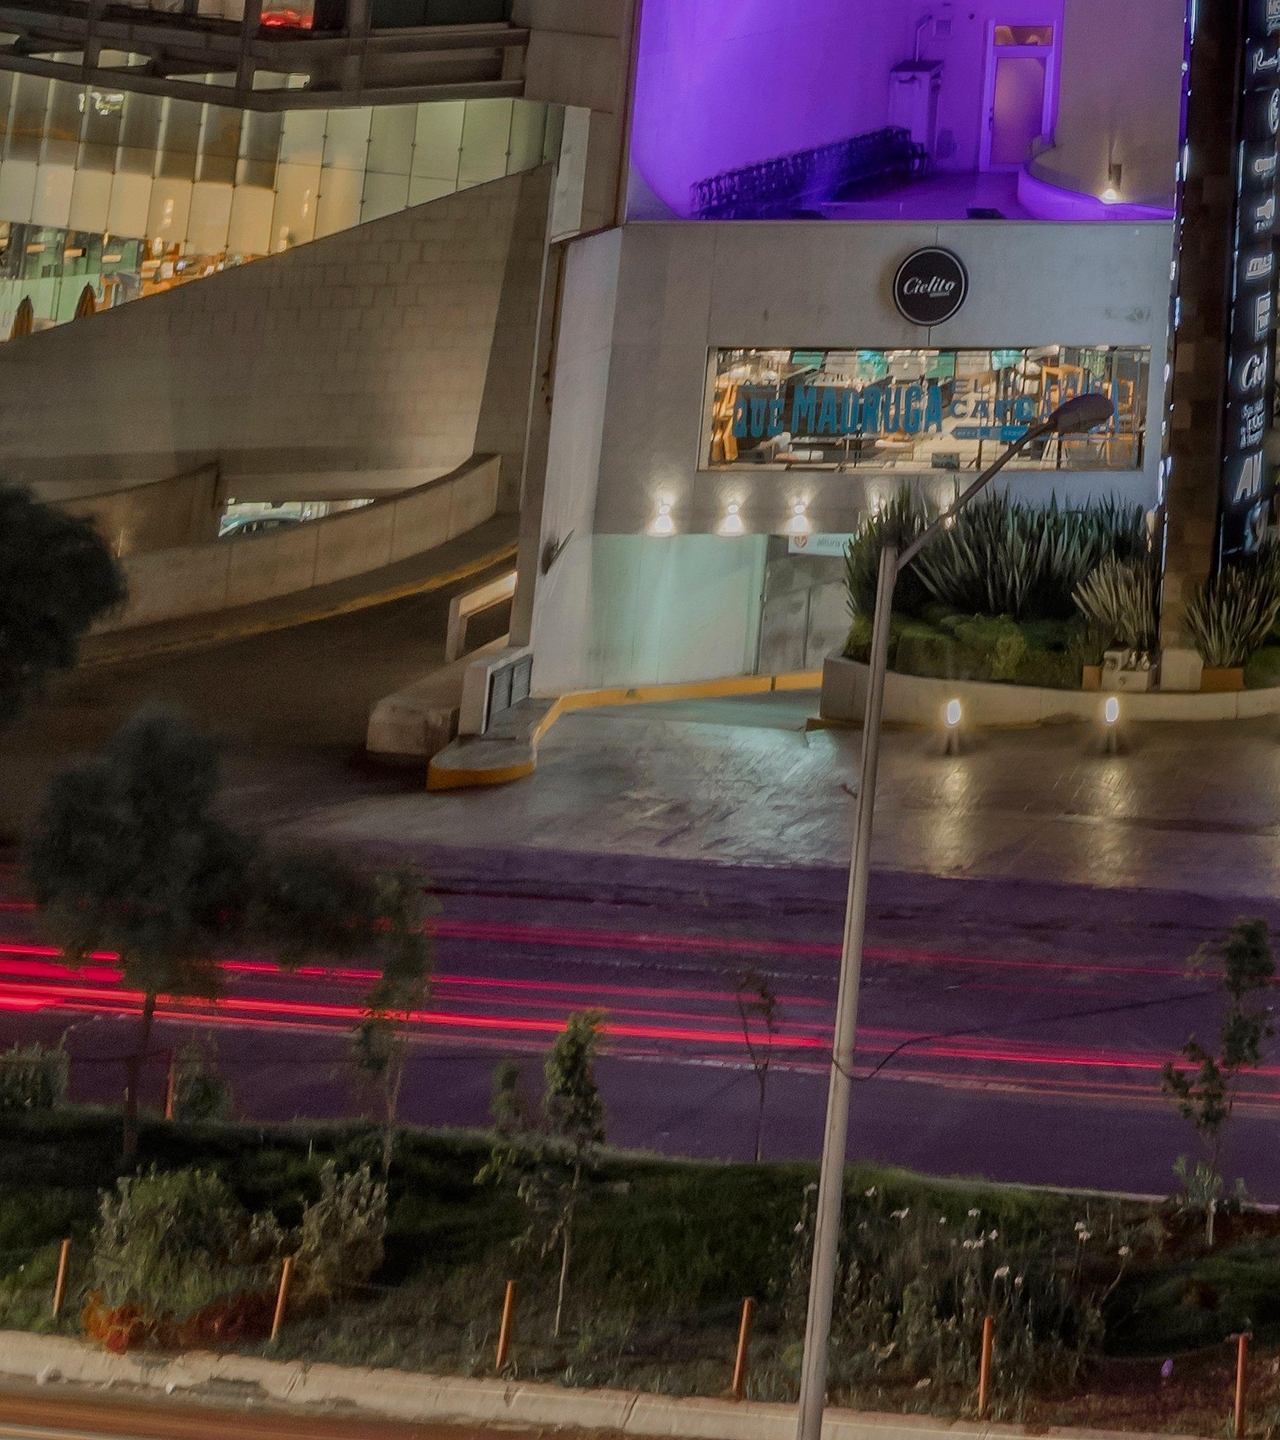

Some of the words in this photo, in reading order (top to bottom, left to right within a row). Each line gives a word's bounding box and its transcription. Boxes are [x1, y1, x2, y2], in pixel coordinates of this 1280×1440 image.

[903, 275, 957, 296] Cielito
[732, 397, 786, 439] QUE
[790, 383, 942, 436] MADRUGA
